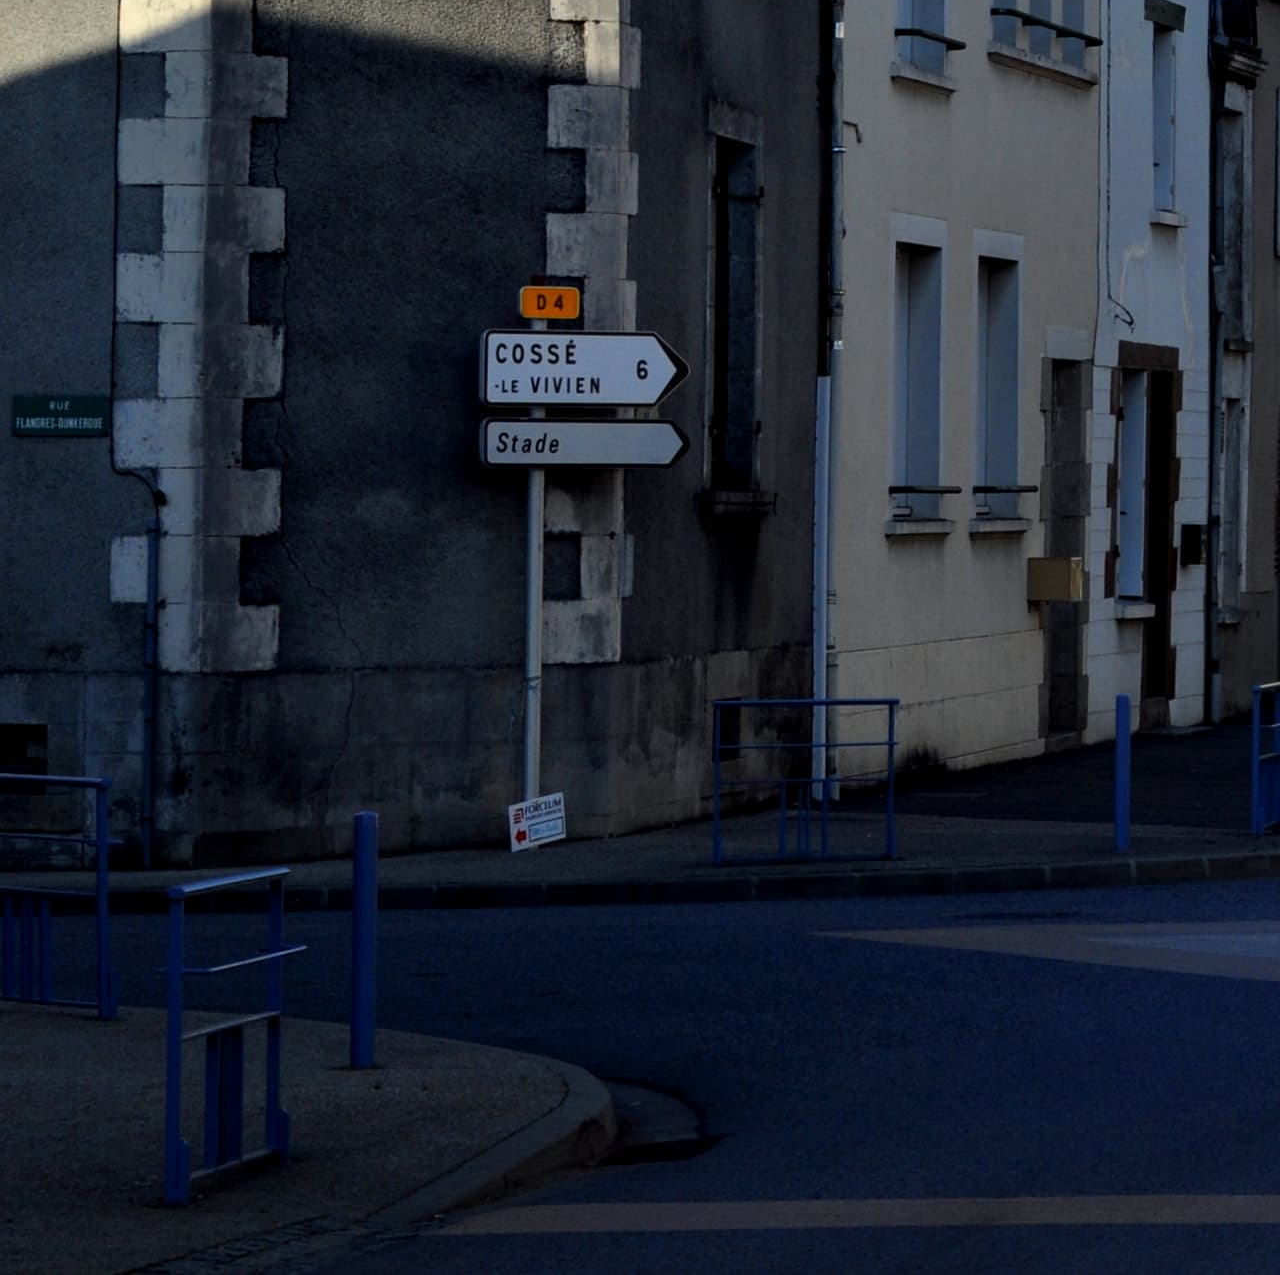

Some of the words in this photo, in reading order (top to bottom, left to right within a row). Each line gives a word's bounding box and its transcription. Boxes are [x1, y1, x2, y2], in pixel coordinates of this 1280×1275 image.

[537, 294, 546, 310] D
[554, 294, 564, 310] 4
[495, 340, 577, 365] COSSÉ
[636, 360, 648, 380] 6
[530, 377, 600, 394] VIVIEN
[49, 401, 71, 411] RUE
[496, 433, 560, 454] Stade
